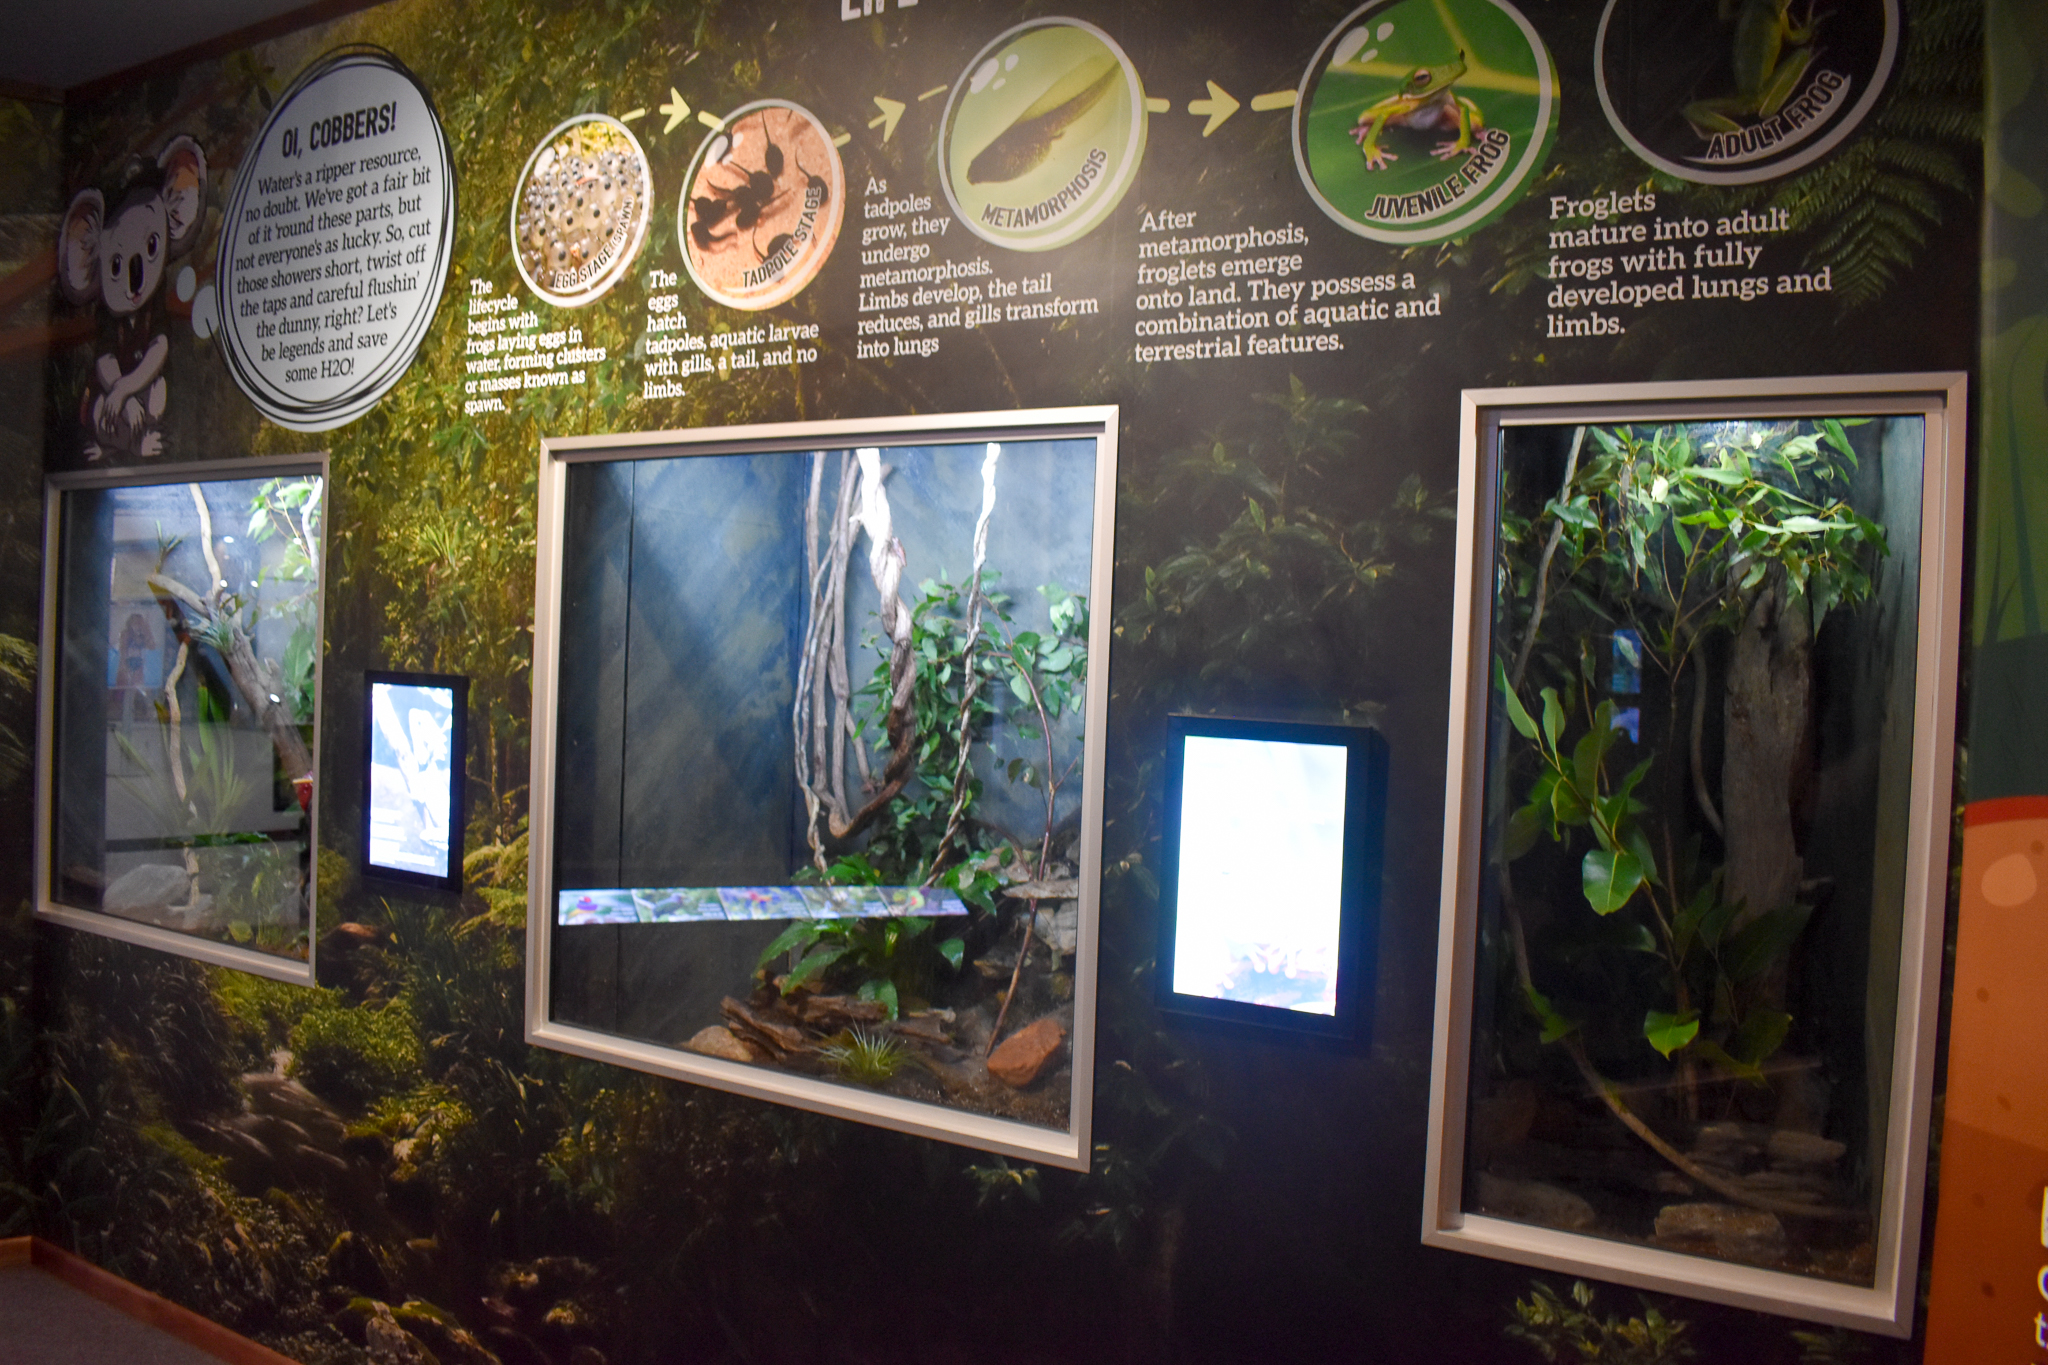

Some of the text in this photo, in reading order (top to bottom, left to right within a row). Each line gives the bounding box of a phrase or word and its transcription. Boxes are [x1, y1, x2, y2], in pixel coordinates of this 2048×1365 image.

[282, 102, 397, 159] OI, COBBERS!
[1708, 71, 1843, 159] ADULT FROG
[258, 147, 421, 196] Water's a ripper resource,
[865, 177, 887, 196] As
[1365, 130, 1509, 218] JUVENILE FROG
[245, 166, 431, 222] no doubt. We've got a fair bit
[981, 148, 1107, 228] METAMORPHOSIS
[249, 195, 421, 245] of it 'round these parts, but
[864, 194, 931, 219] tadpoles
[1140, 210, 1196, 232] After
[1550, 191, 1656, 220] Froglets
[236, 218, 431, 271] not everyone's as lucky. So, cut
[555, 198, 633, 288] EGG STAGE (SPAWN)
[743, 188, 820, 287] TADPOLE STAGE
[862, 216, 950, 246] grow, they
[1139, 222, 1309, 259] metamorphosis,
[1549, 208, 1790, 249] mature into adult
[237, 245, 426, 294] those showers short, twist off
[861, 243, 930, 265] undergo
[1137, 254, 1302, 286] froglets emerge
[1548, 242, 1762, 280] frogs with fully
[470, 278, 492, 296] The
[650, 269, 677, 288] The
[860, 256, 993, 289] metamorphosis.
[1548, 266, 1832, 308] developed lungs and
[240, 271, 419, 317] the taps and careful flushin'
[468, 293, 518, 315] lifecycle
[648, 294, 678, 313] eggs
[858, 273, 1052, 312] Limbs develop, the tail
[1136, 273, 1415, 310] onto land. They possess a
[257, 302, 397, 339] the dunny, right? Let's
[468, 311, 538, 337] begins with
[646, 312, 687, 332] hatch
[858, 296, 1099, 335] reduces, and gills transform
[1135, 293, 1441, 337] combination of aquatic and
[1546, 312, 1626, 338] limbs.
[261, 332, 387, 362] be legends and save
[467, 326, 582, 355] frogs laying eggs in
[645, 324, 819, 355] tadpoles, aquatic larvae
[857, 336, 939, 359] into lungs
[1135, 333, 1344, 363] terrestrial features.
[285, 364, 317, 383] some
[466, 347, 606, 374] water, forming clusters
[645, 345, 818, 377] with gills, a tail, and no
[465, 370, 586, 394] or masses known as
[643, 379, 685, 399] limbs.
[464, 397, 505, 416] spawn.
